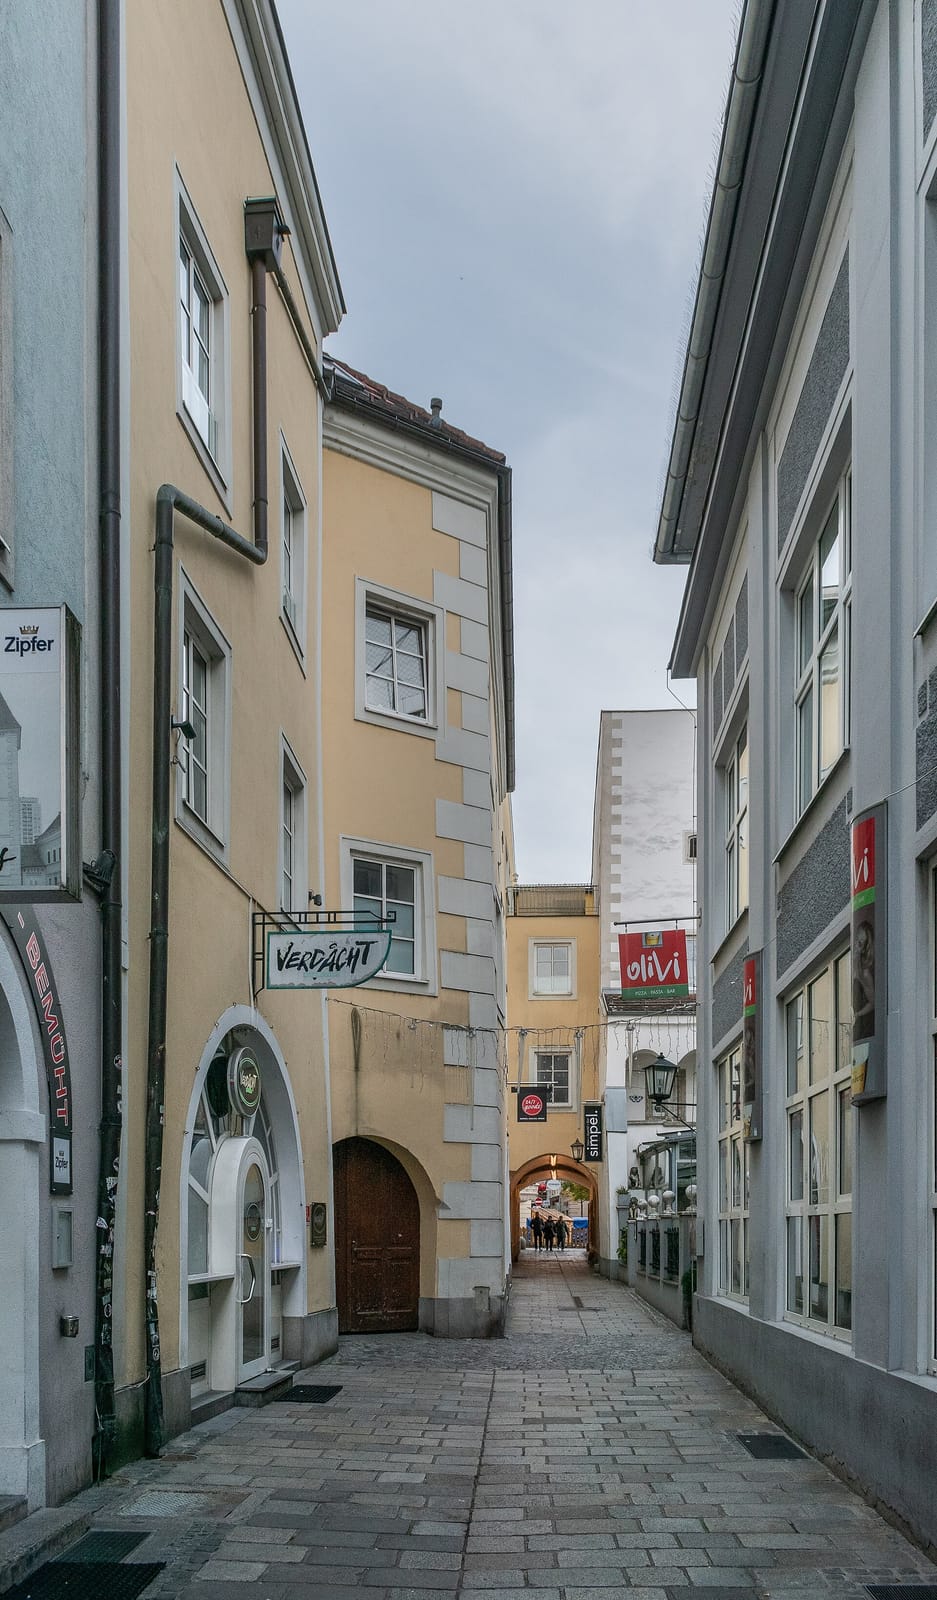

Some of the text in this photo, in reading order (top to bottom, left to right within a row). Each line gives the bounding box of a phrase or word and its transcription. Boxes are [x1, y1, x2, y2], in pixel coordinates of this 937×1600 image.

[5, 636, 54, 657] Zipfer
[26, 931, 68, 1126] BEMÜHT
[585, 1110, 601, 1157] simpel.
